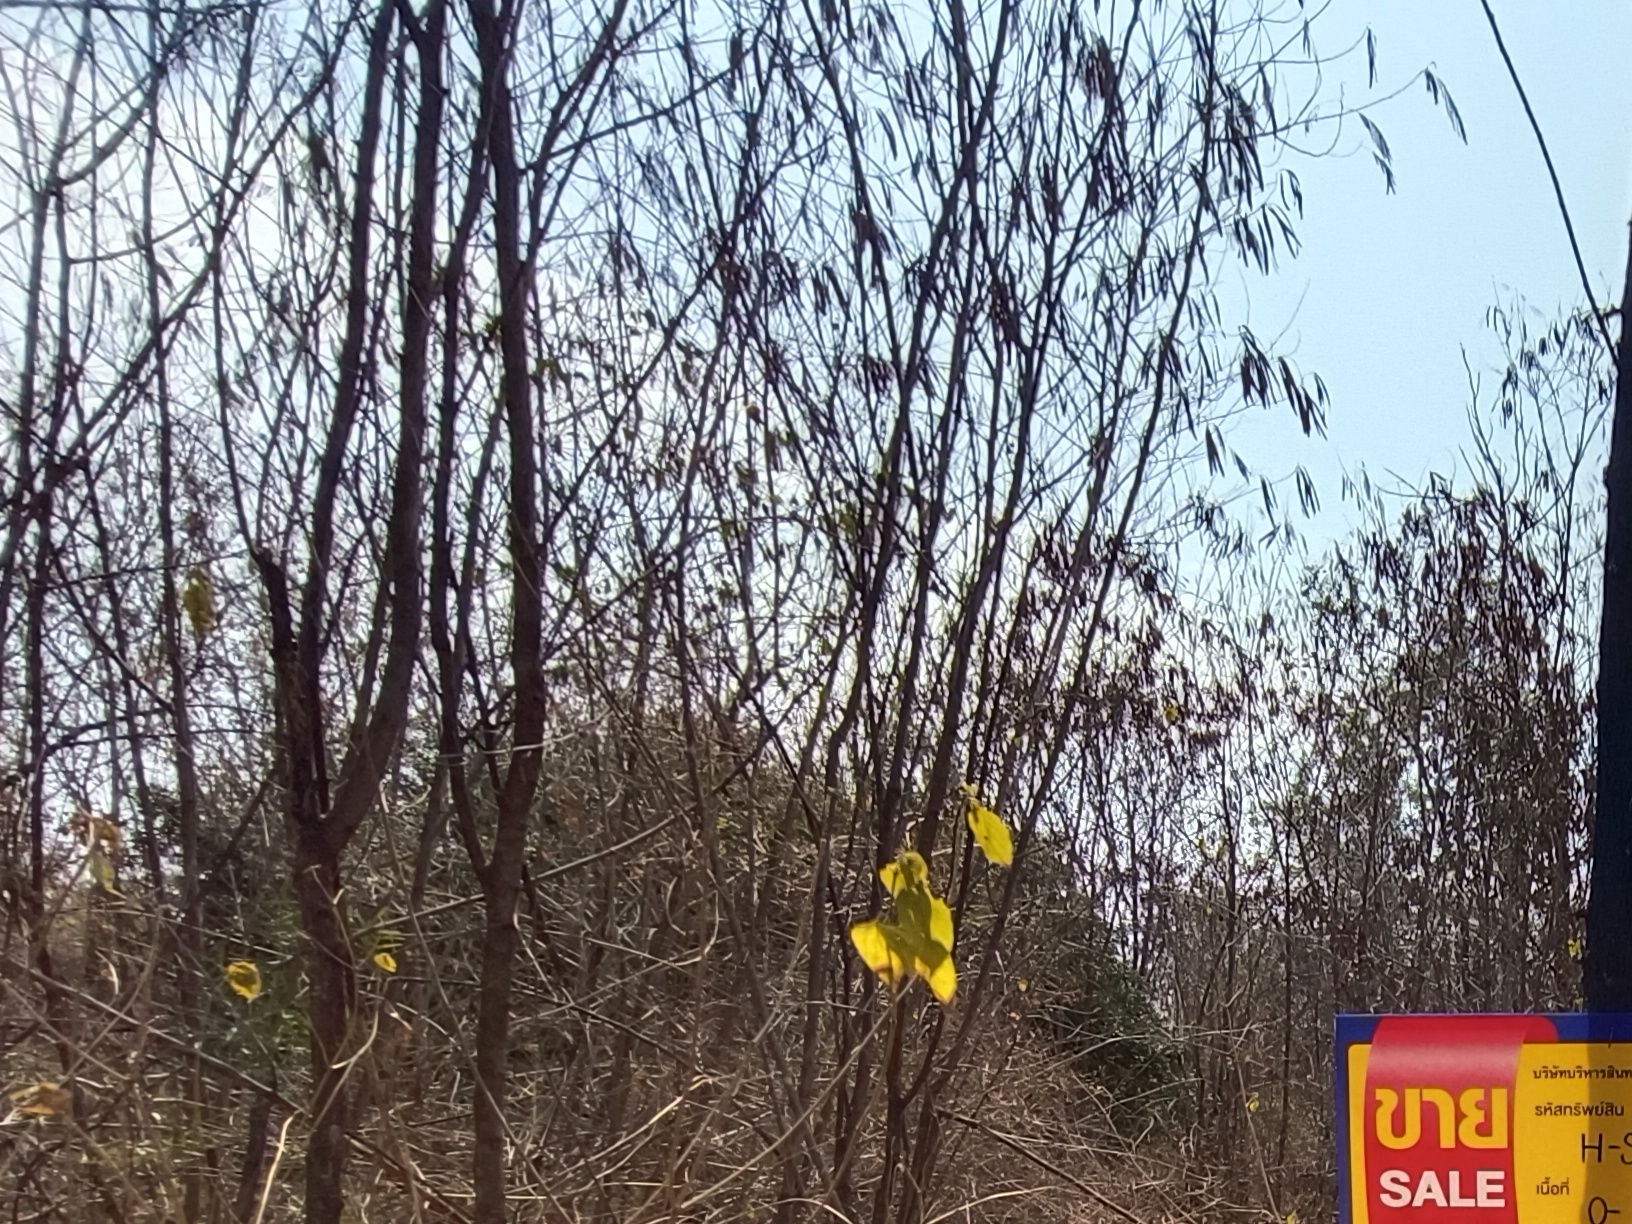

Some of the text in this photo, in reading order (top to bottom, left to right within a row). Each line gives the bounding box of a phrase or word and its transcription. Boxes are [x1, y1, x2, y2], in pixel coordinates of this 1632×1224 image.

[1375, 1088, 1508, 1149] ขาย
[1534, 1101, 1625, 1117] รหัสทรัพย์สิน
[1379, 1169, 1506, 1208] SALE
[1536, 1176, 1570, 1196] เนื้อที่
